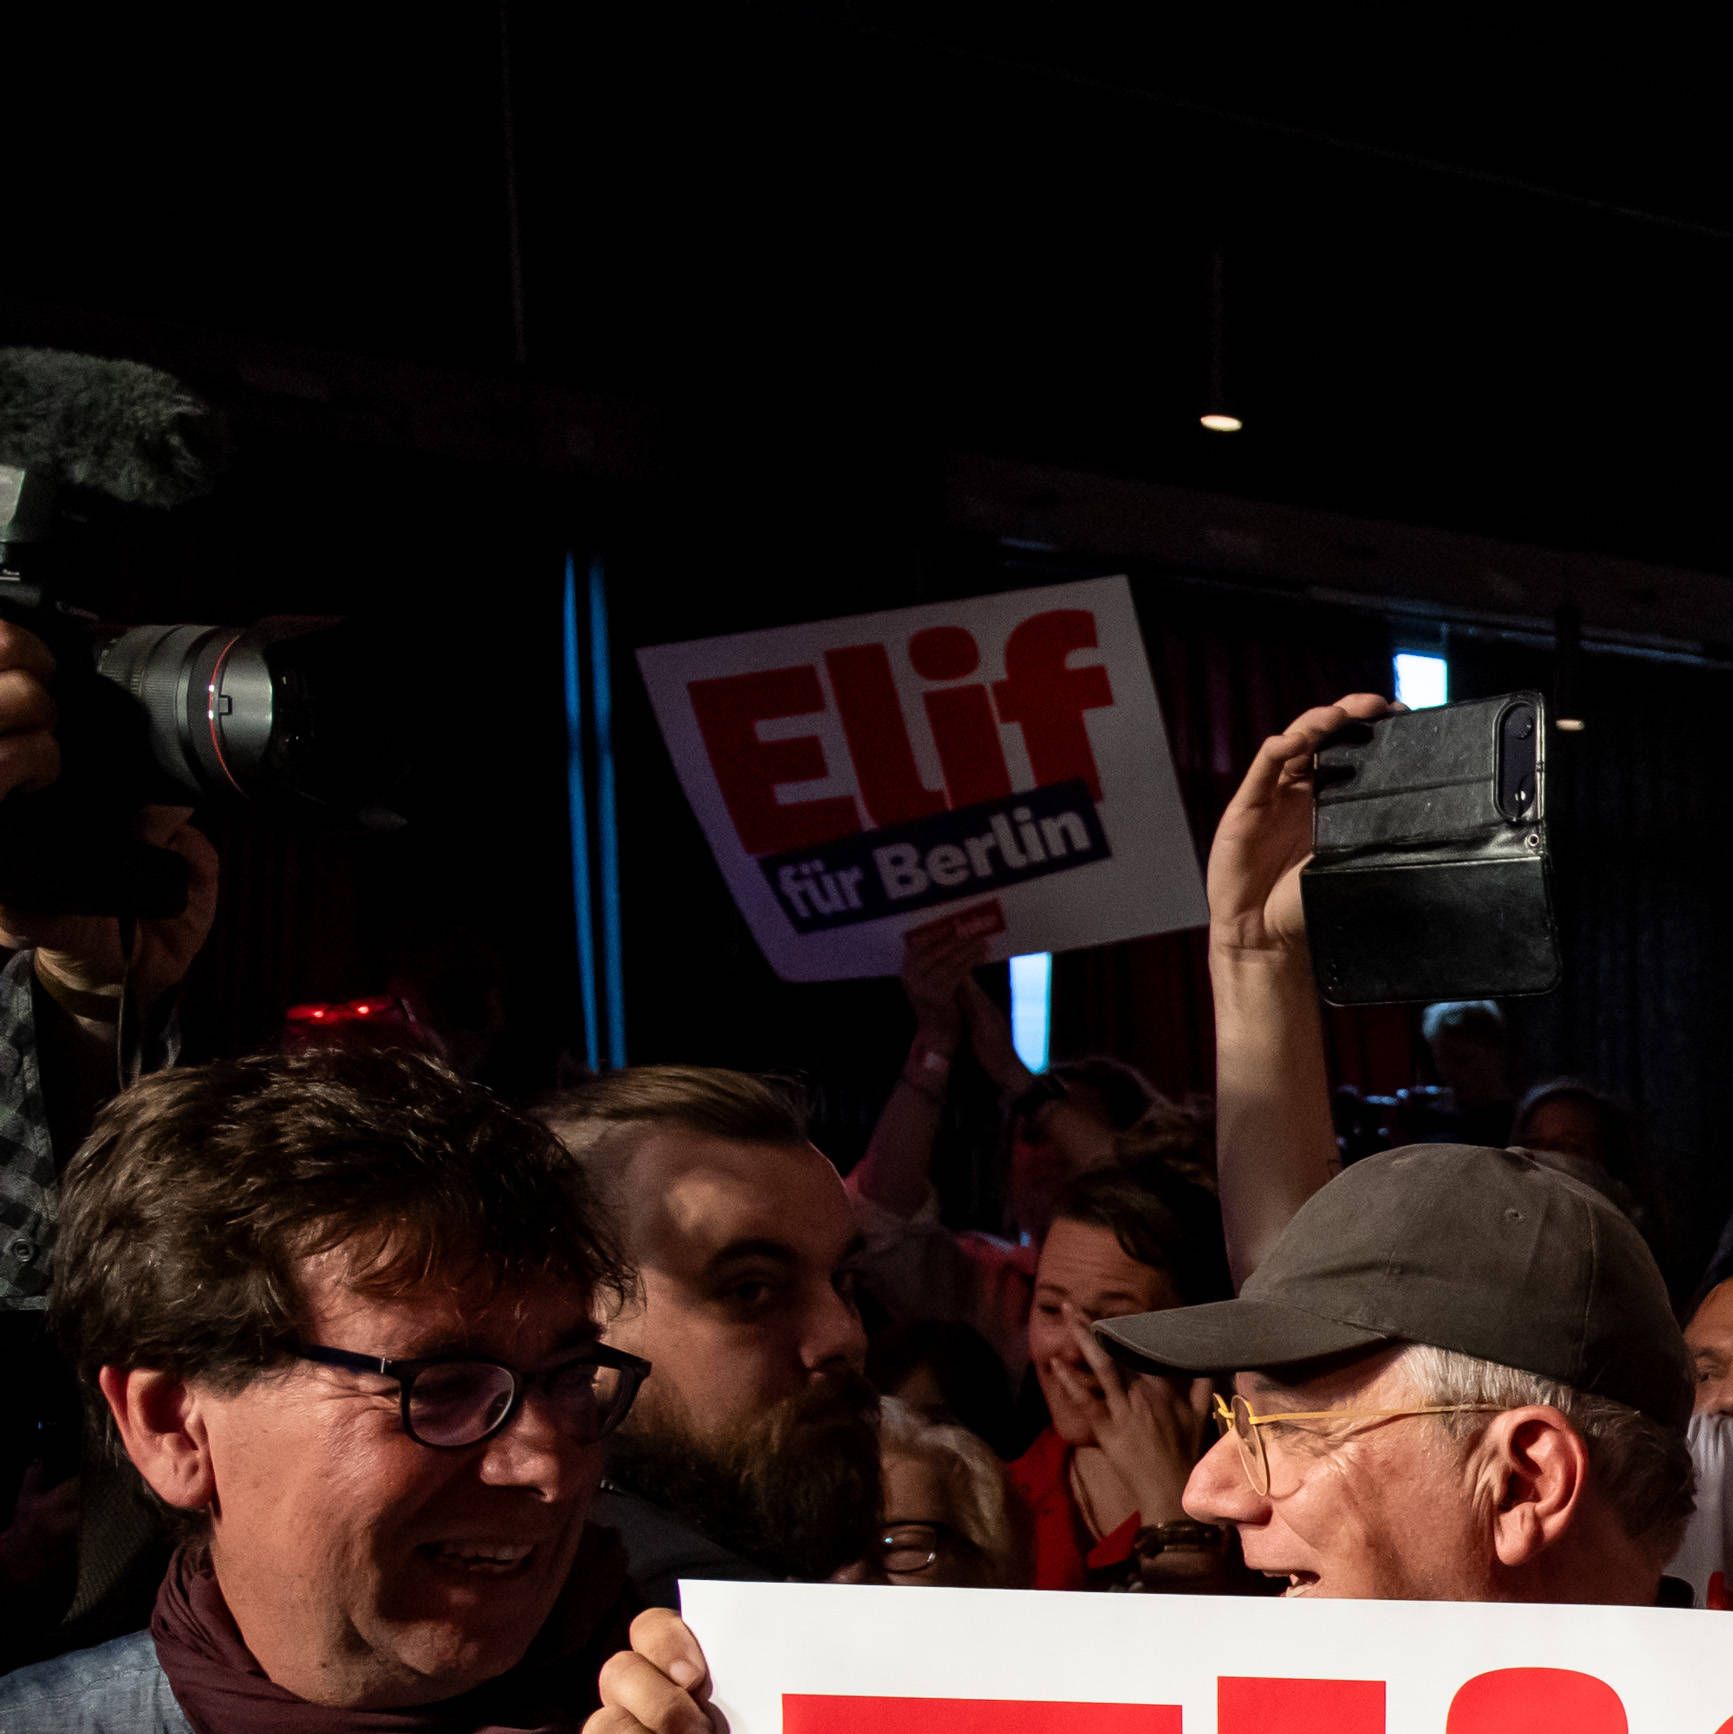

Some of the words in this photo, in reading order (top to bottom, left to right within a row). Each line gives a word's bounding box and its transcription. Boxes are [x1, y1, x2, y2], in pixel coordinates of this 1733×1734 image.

[687, 609, 1114, 854] Elif
[777, 858, 865, 919] für
[871, 805, 1093, 900] Berlin
